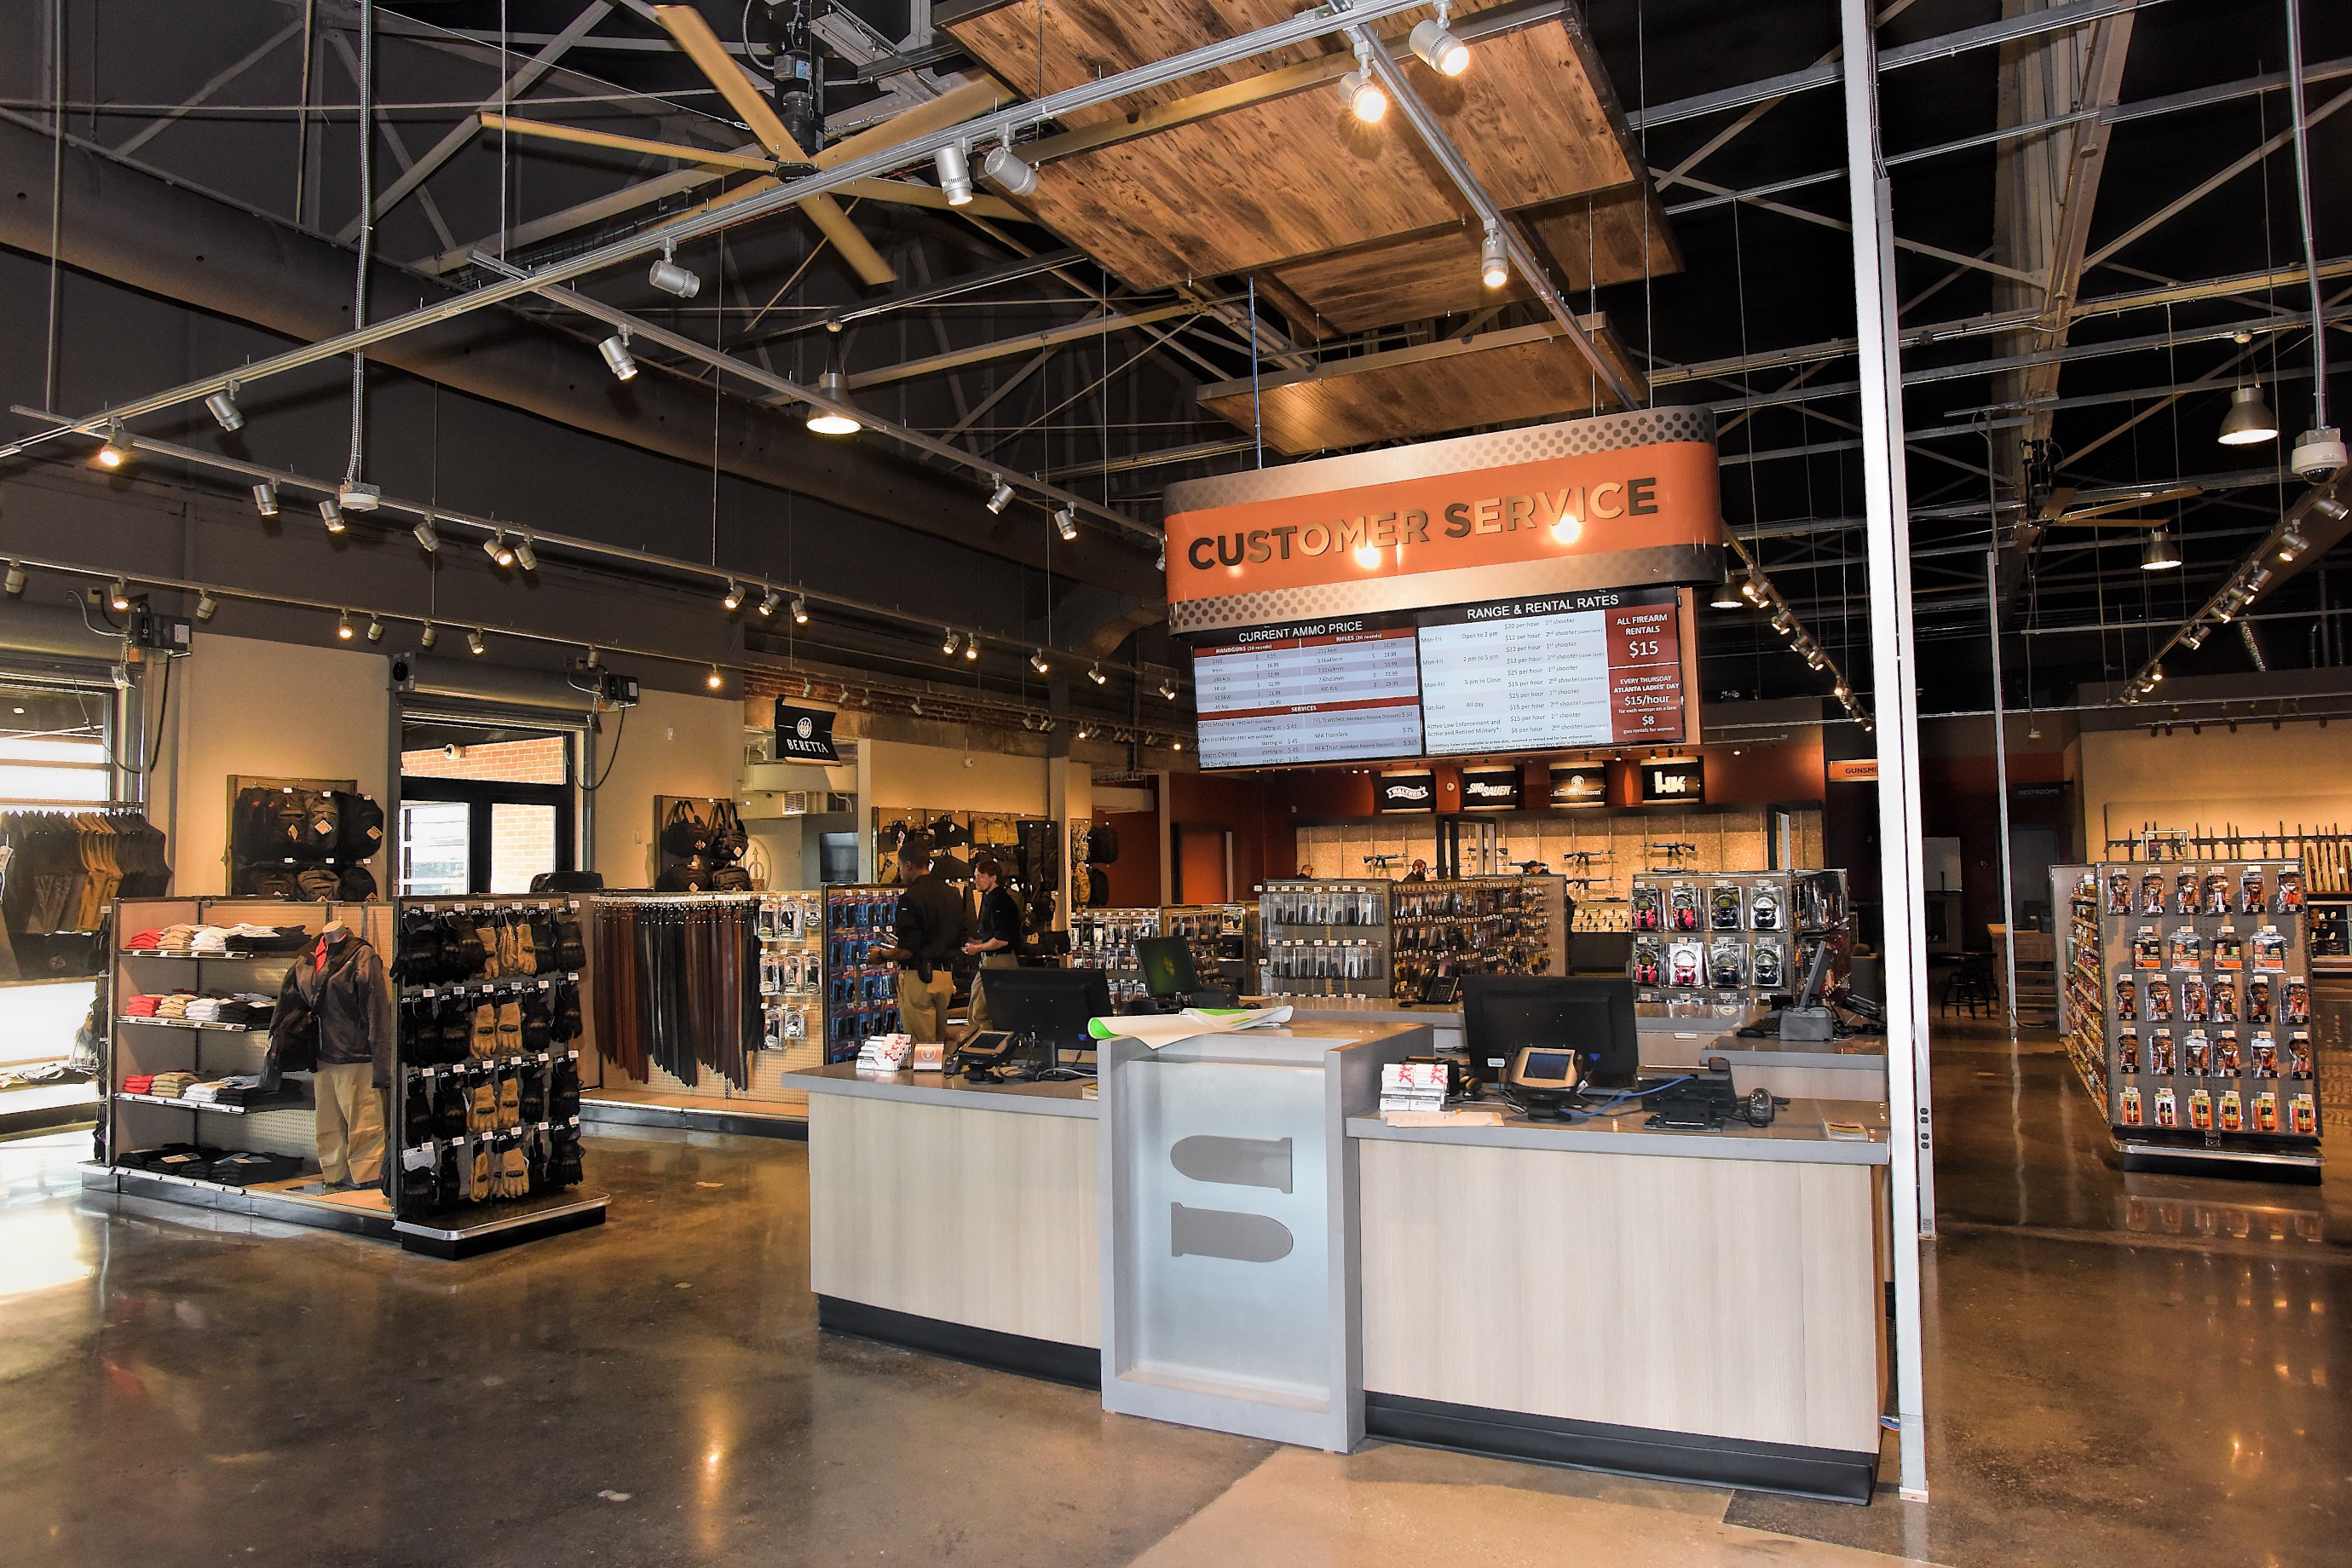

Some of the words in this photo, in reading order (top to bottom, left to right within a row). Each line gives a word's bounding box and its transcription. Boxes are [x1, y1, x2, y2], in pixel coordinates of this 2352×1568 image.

[1188, 509, 1430, 570] CUSTOMER
[1444, 476, 1658, 539] SERVICE
[1467, 605, 1510, 620] RANGE
[1513, 604, 1523, 615] &
[1525, 600, 1574, 613] RENTAL
[1577, 595, 1619, 608] RATES
[1617, 617, 1631, 625] ALL
[1632, 614, 1668, 624] FIREARM
[1238, 628, 1290, 643] CURRENT
[1292, 624, 1326, 638] AMMO
[1329, 620, 1363, 634] PRICE
[1625, 625, 1661, 636] RENTALS
[1336, 634, 1354, 643] RIFLES
[1216, 645, 1247, 654] HANDGUNS
[1629, 640, 1659, 659] $15
[1640, 675, 1672, 683] THURSDAY
[1613, 685, 1641, 694] ATLANTA
[1624, 695, 1671, 707] $15/hour
[1291, 705, 1317, 713] SERVICES
[1642, 715, 1655, 726] $8
[786, 738, 830, 754] BERETTA
[1467, 782, 1485, 795] SIG
[1482, 785, 1513, 798] SAUER
